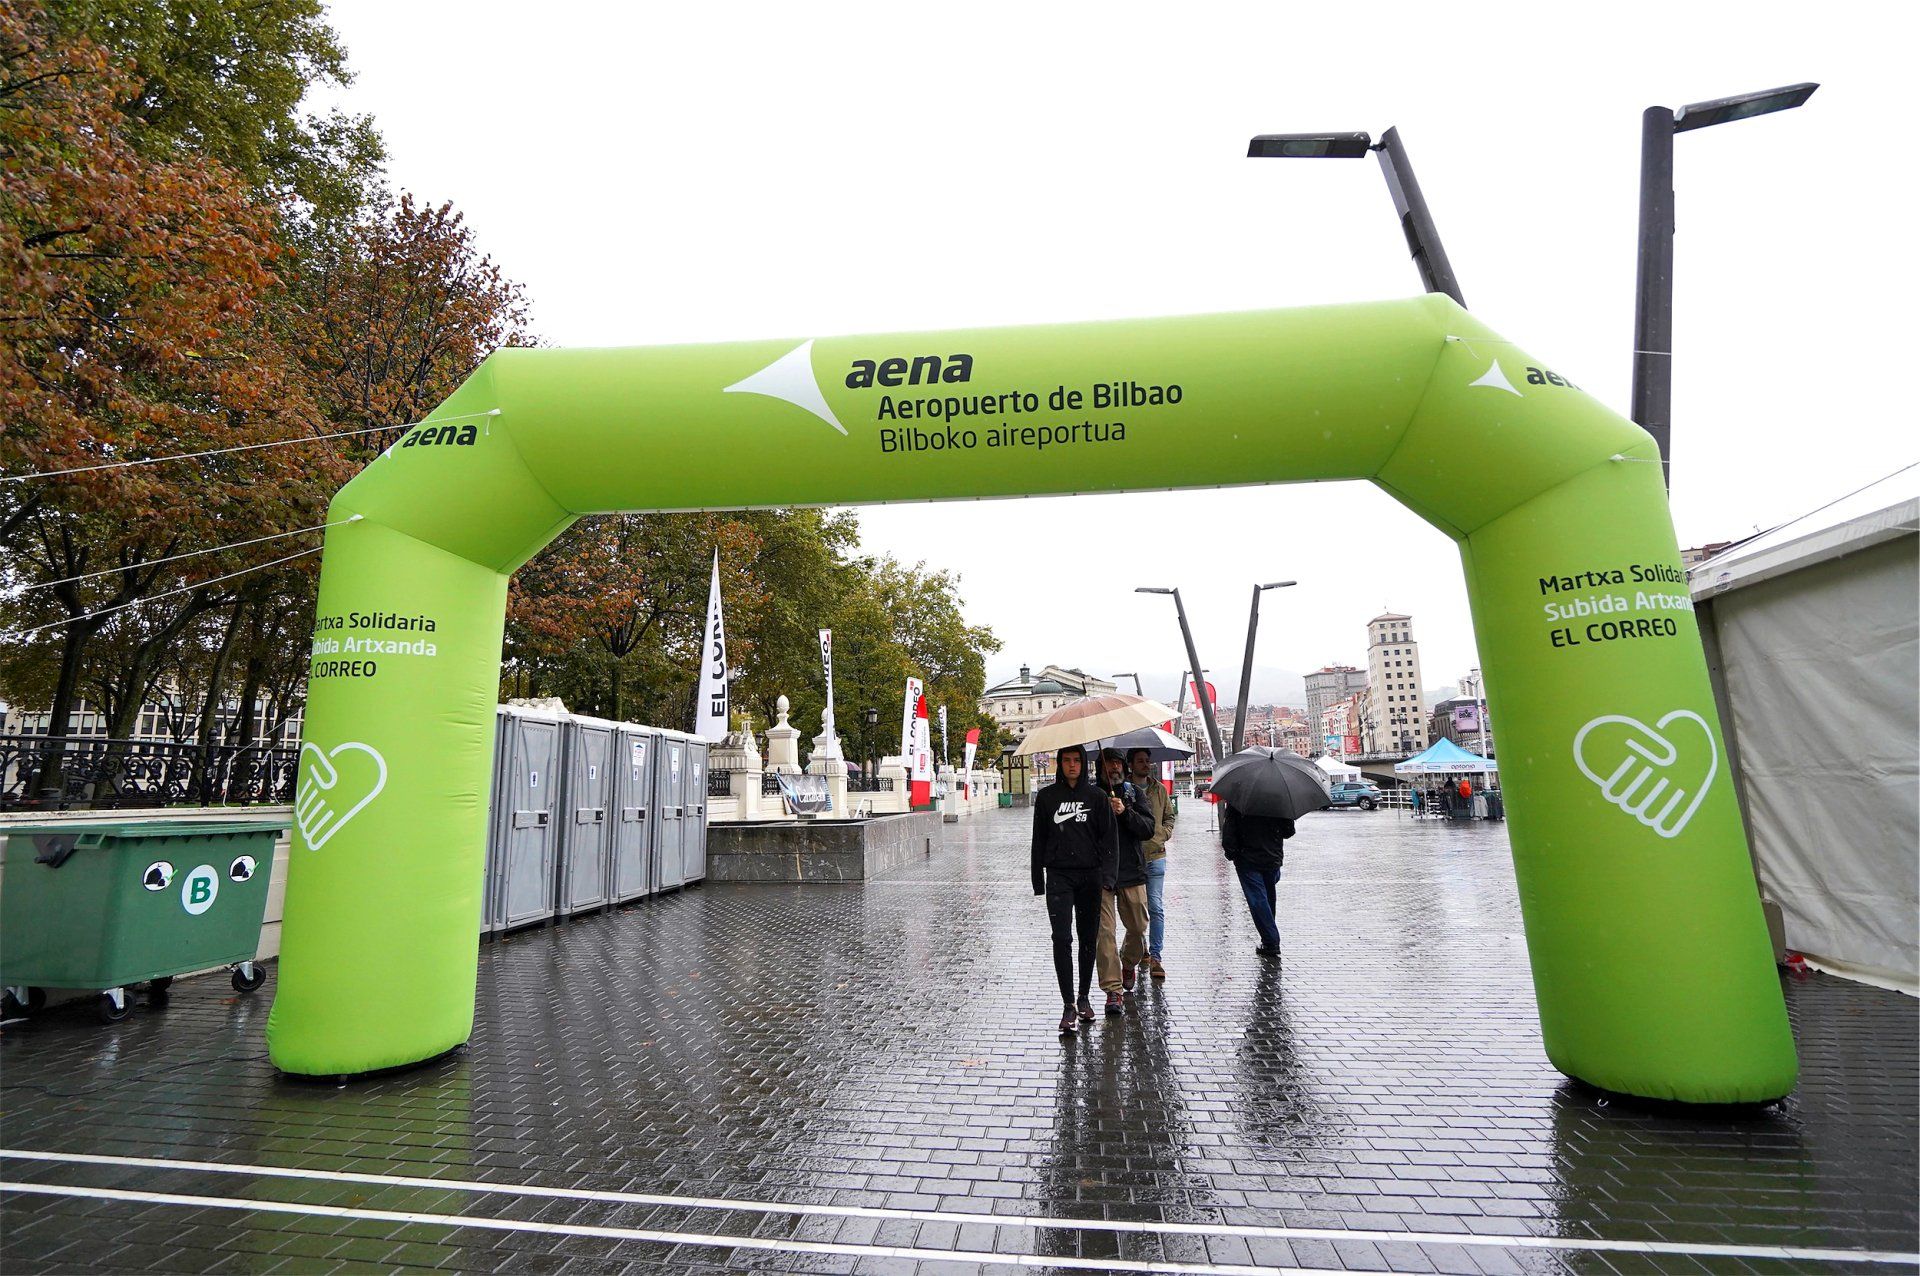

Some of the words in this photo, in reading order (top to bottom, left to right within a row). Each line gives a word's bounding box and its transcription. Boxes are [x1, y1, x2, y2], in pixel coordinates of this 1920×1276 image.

[845, 353, 973, 389] aena
[878, 391, 1039, 422] Aeropuerto
[1048, 386, 1083, 411] de
[1093, 381, 1183, 408] Bilbao
[402, 424, 477, 448] aena
[880, 426, 977, 452] Bilboko
[986, 420, 1125, 450] aireportua
[1539, 569, 1624, 595] Martxa
[1544, 594, 1628, 622] Subida
[1635, 591, 1695, 612] Artxan
[316, 615, 343, 631] artxa
[349, 612, 436, 632] Solidaria
[1551, 628, 1580, 648] EL
[1586, 618, 1676, 643] CORREO
[343, 636, 437, 656] Artxanda
[315, 661, 377, 678] CORREO
[712, 684, 726, 717] EL
[1058, 801, 1084, 813] NIKE
[1075, 813, 1088, 822] SB
[190, 877, 211, 904] B
